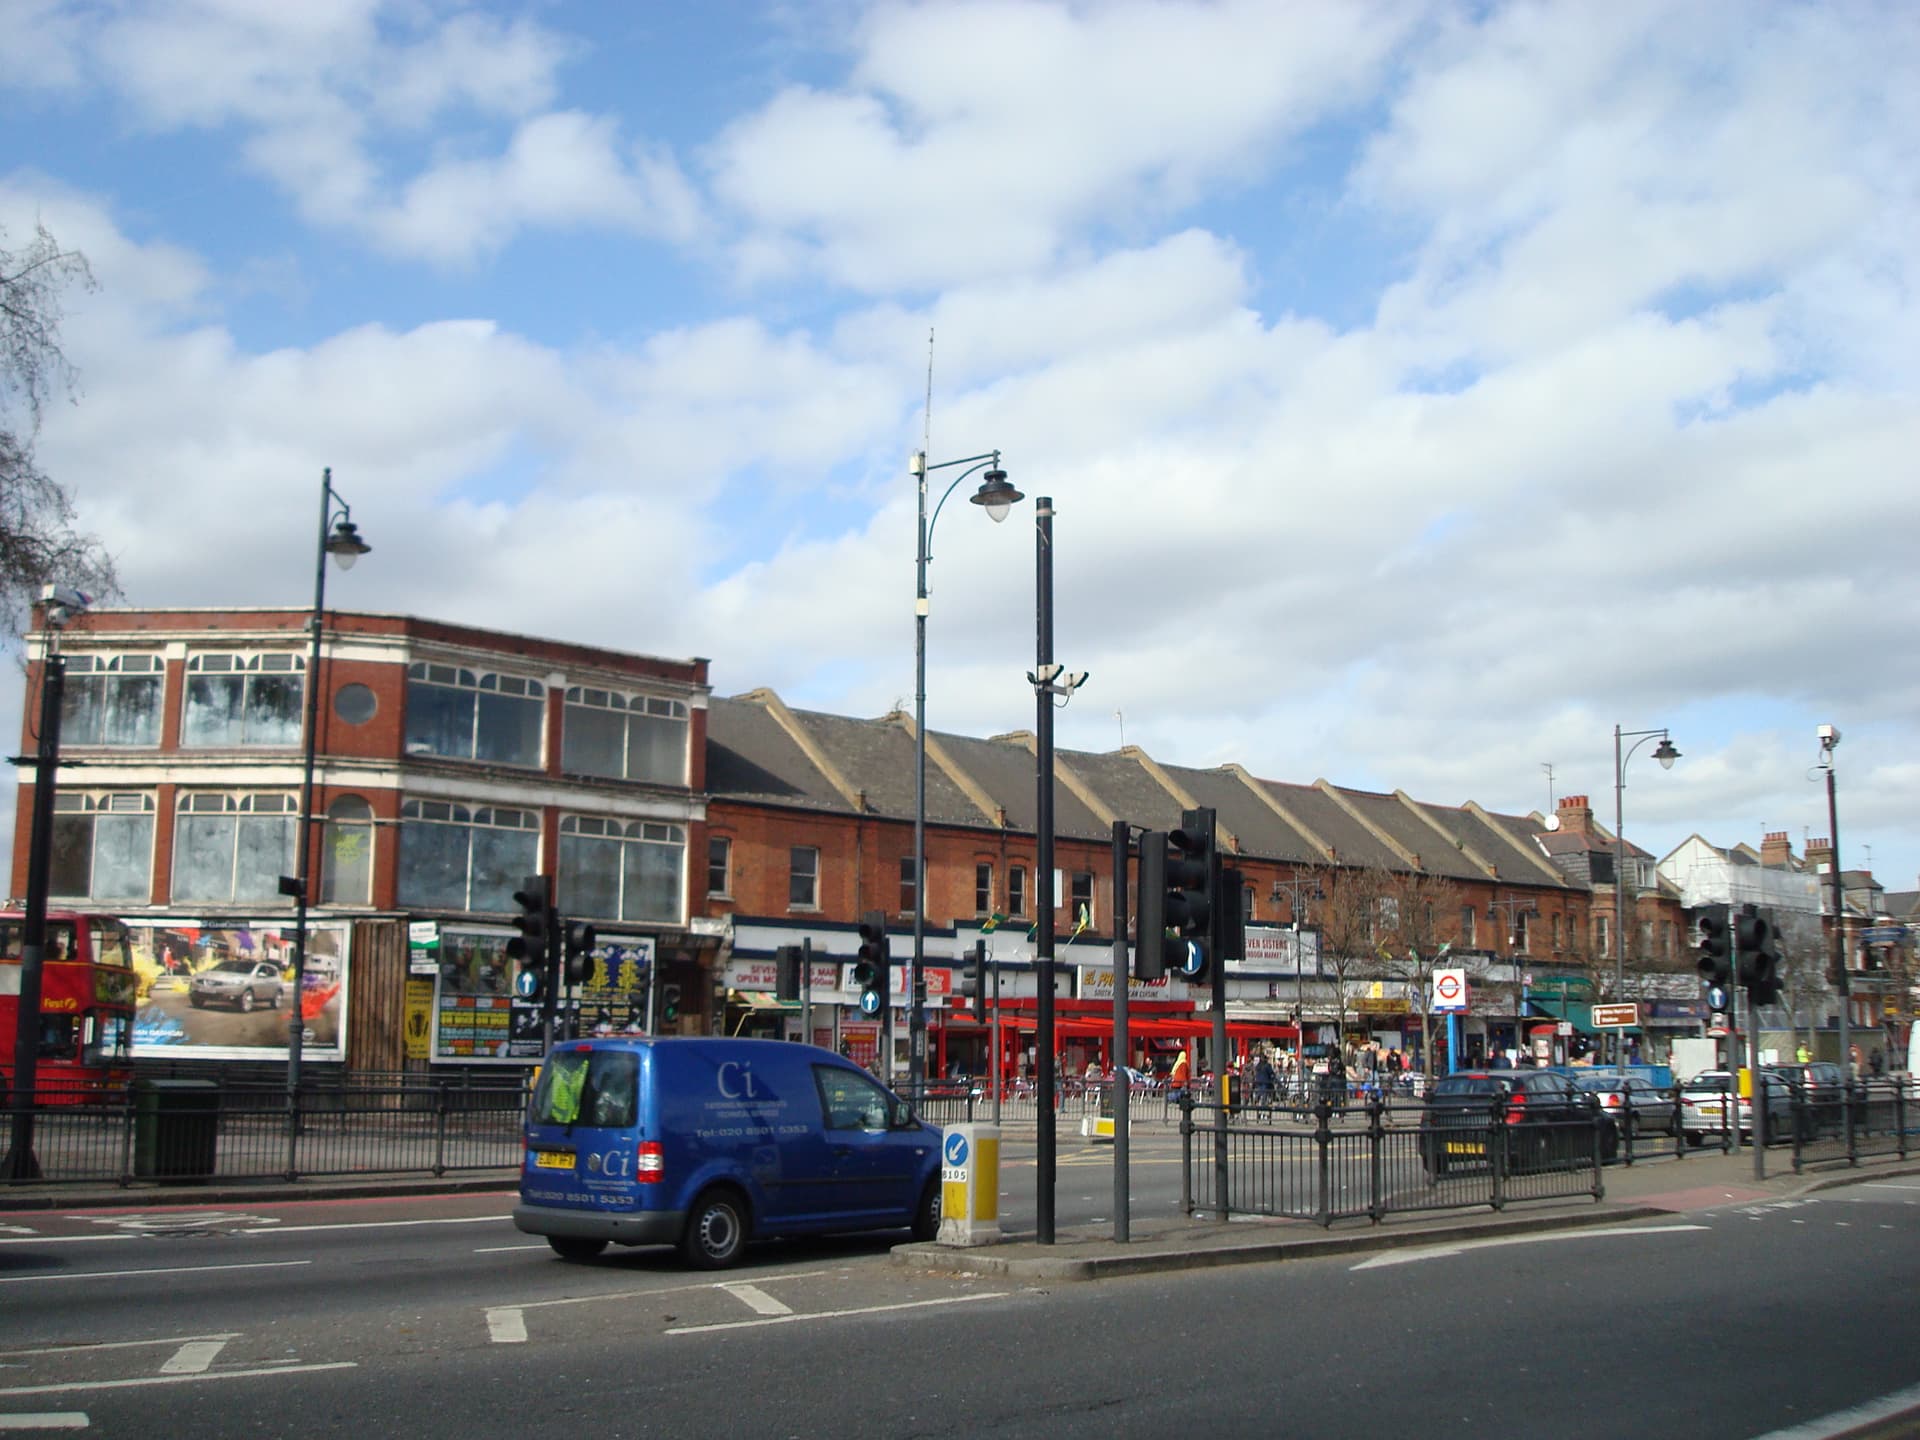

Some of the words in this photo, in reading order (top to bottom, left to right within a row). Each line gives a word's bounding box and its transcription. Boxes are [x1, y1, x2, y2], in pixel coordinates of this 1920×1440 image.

[1247, 938, 1262, 949] VEN
[1263, 939, 1288, 950] SISTERS
[1247, 950, 1263, 958] NDOOR
[717, 1060, 758, 1099] Ci
[602, 1149, 631, 1178] Ci
